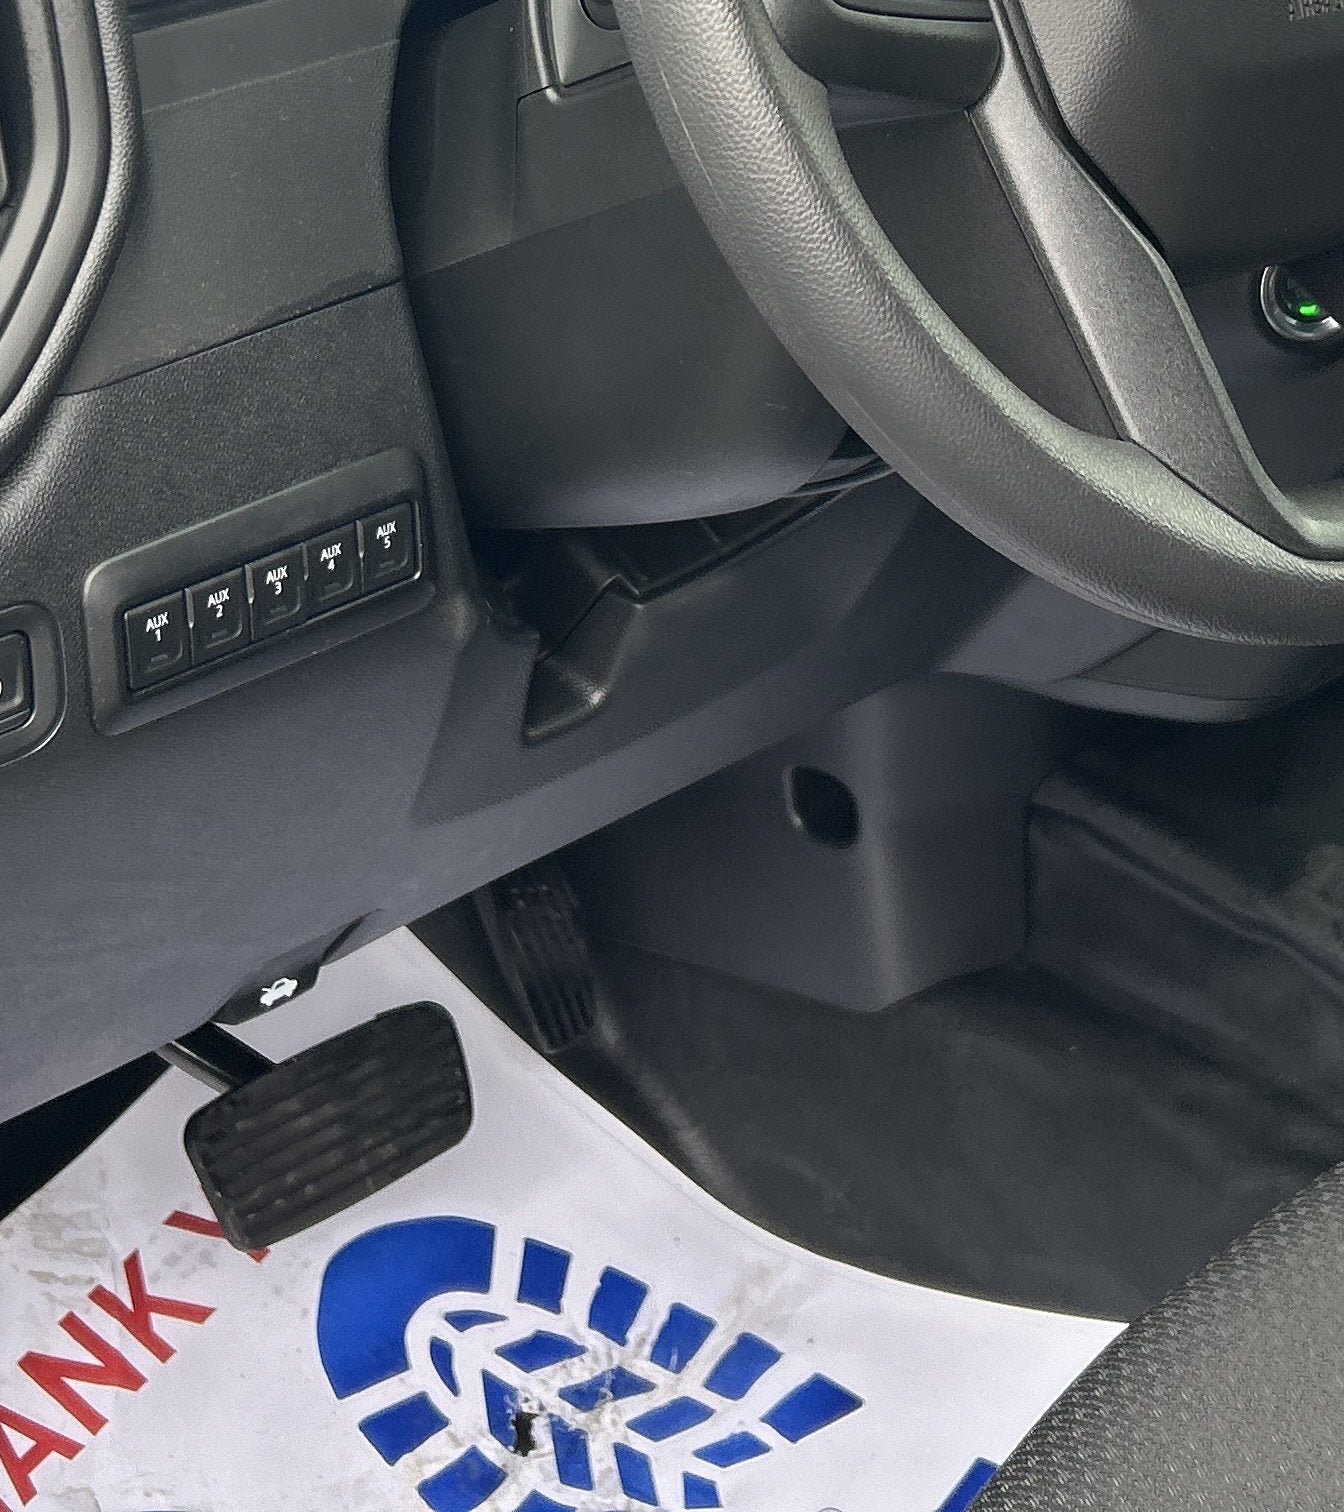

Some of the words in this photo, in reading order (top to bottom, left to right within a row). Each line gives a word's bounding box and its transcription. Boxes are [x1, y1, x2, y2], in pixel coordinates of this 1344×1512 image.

[376, 520, 397, 540] AUX
[383, 536, 392, 549] 5
[320, 542, 342, 563] AUX
[327, 558, 336, 571] 4
[265, 564, 289, 585] AUX
[274, 581, 283, 595] 3
[207, 587, 230, 608] AUX
[215, 605, 224, 618] 2
[145, 611, 169, 633] AUX
[154, 629, 162, 642] 1
